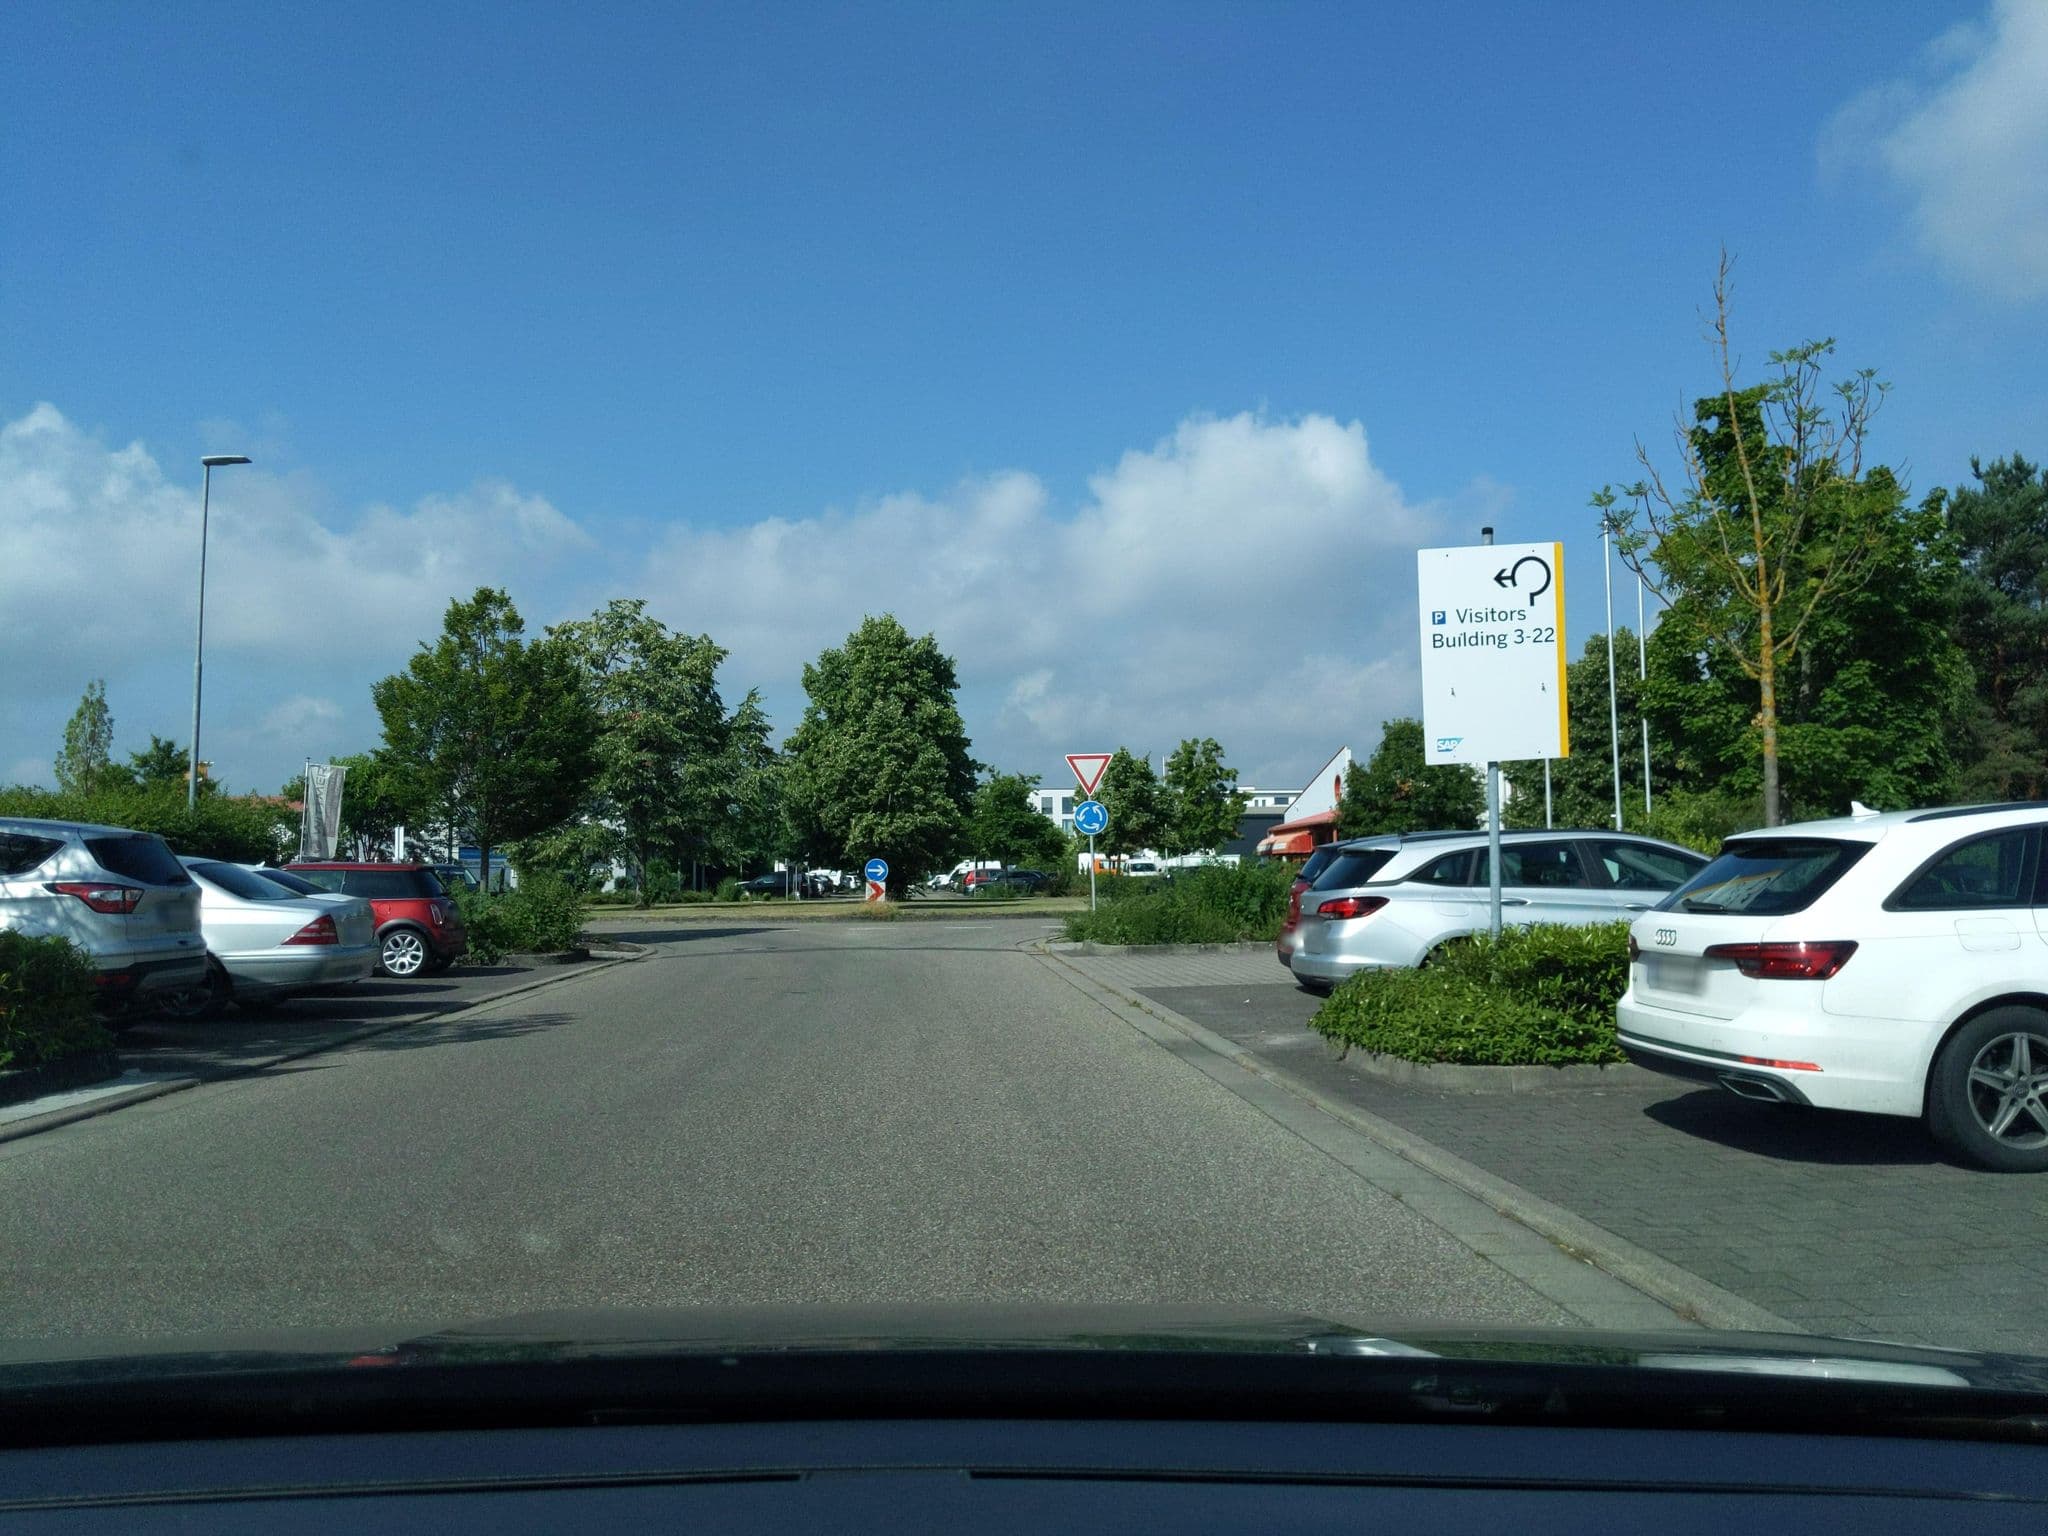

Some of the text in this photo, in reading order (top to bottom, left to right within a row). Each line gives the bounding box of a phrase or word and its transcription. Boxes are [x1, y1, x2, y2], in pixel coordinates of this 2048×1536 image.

[1456, 608, 1527, 624] Visitors
[1432, 627, 1555, 649] Building 3-22
[1437, 738, 1460, 751] SAP
